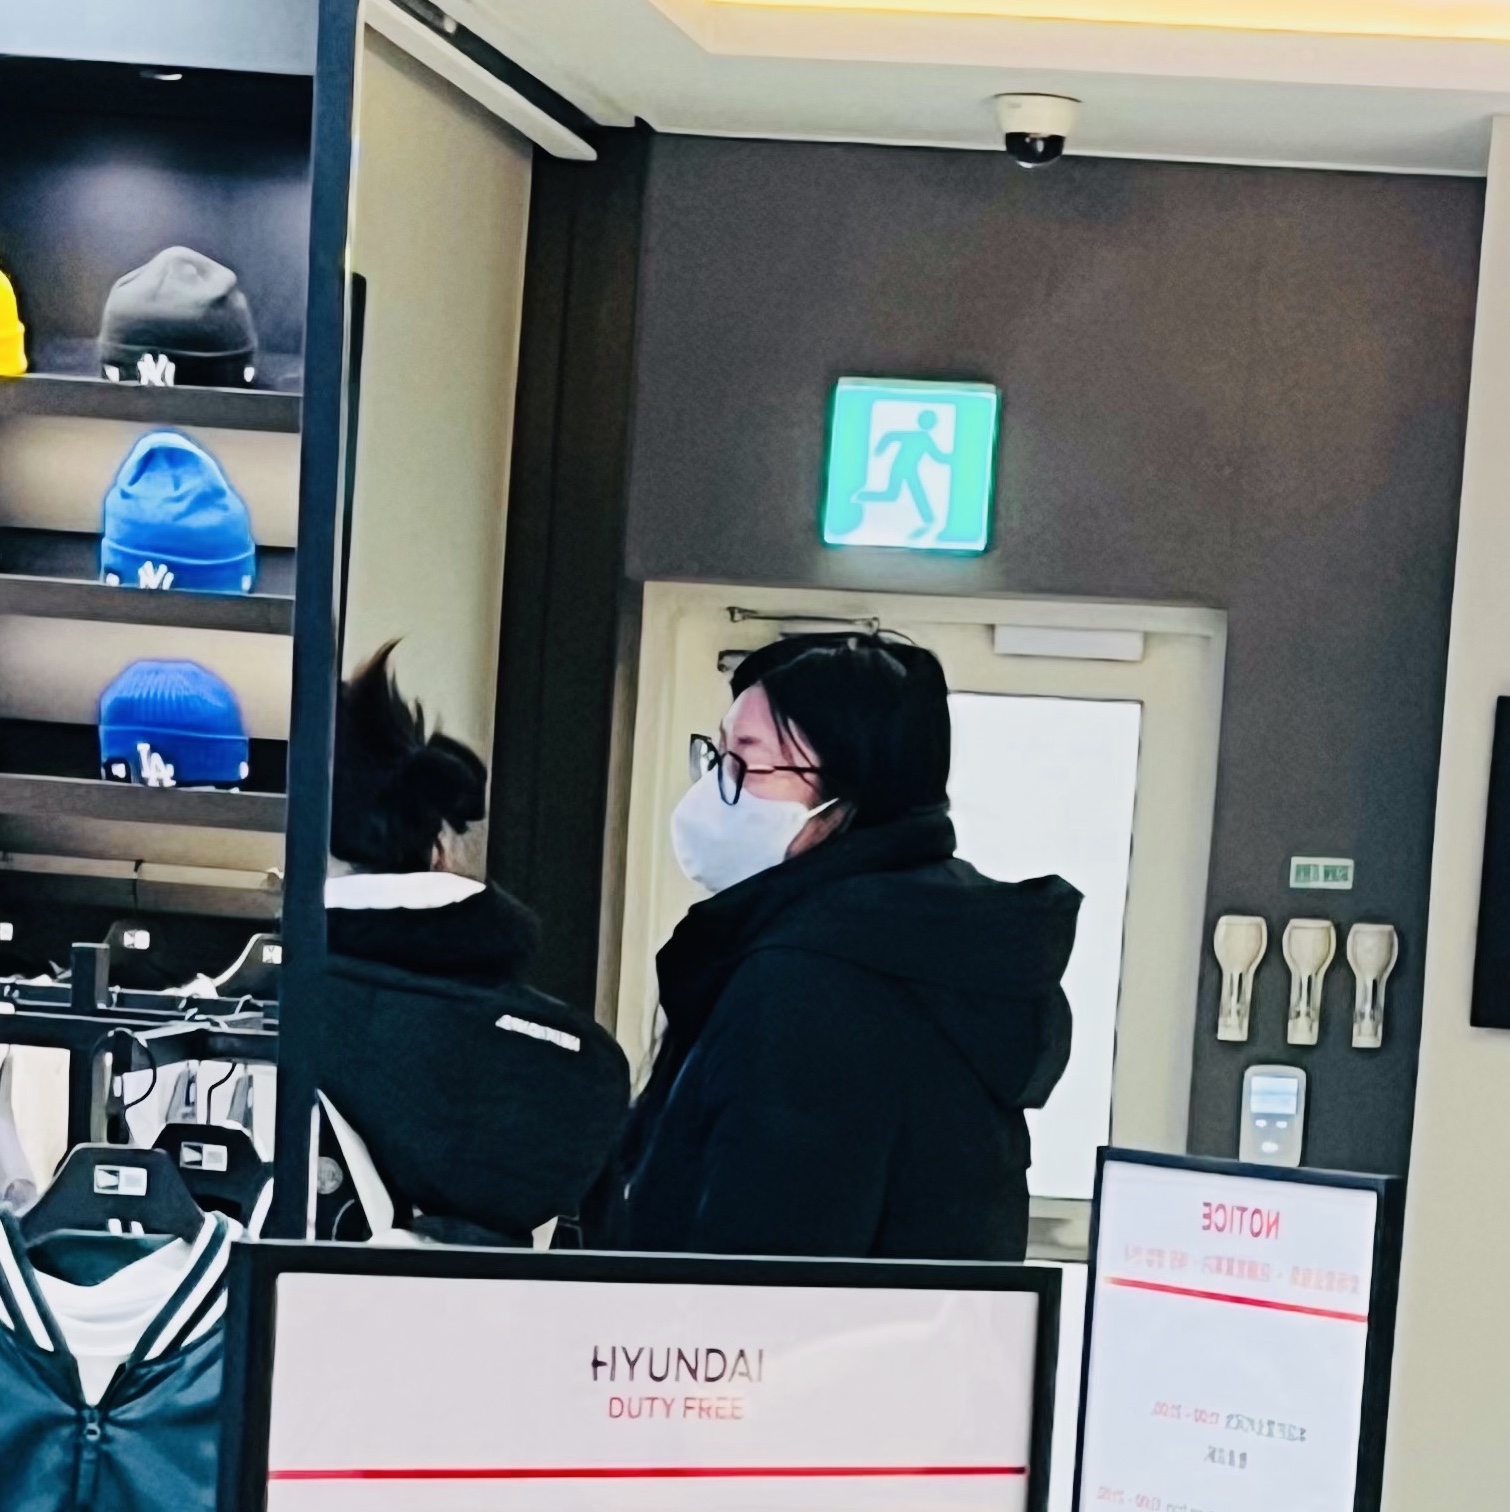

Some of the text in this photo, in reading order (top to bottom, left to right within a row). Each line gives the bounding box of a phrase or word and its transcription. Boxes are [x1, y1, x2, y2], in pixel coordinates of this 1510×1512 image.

[137, 743, 176, 787] LA
[591, 1345, 764, 1382] HYUNDAI
[609, 1396, 744, 1419] DUTY FREE
